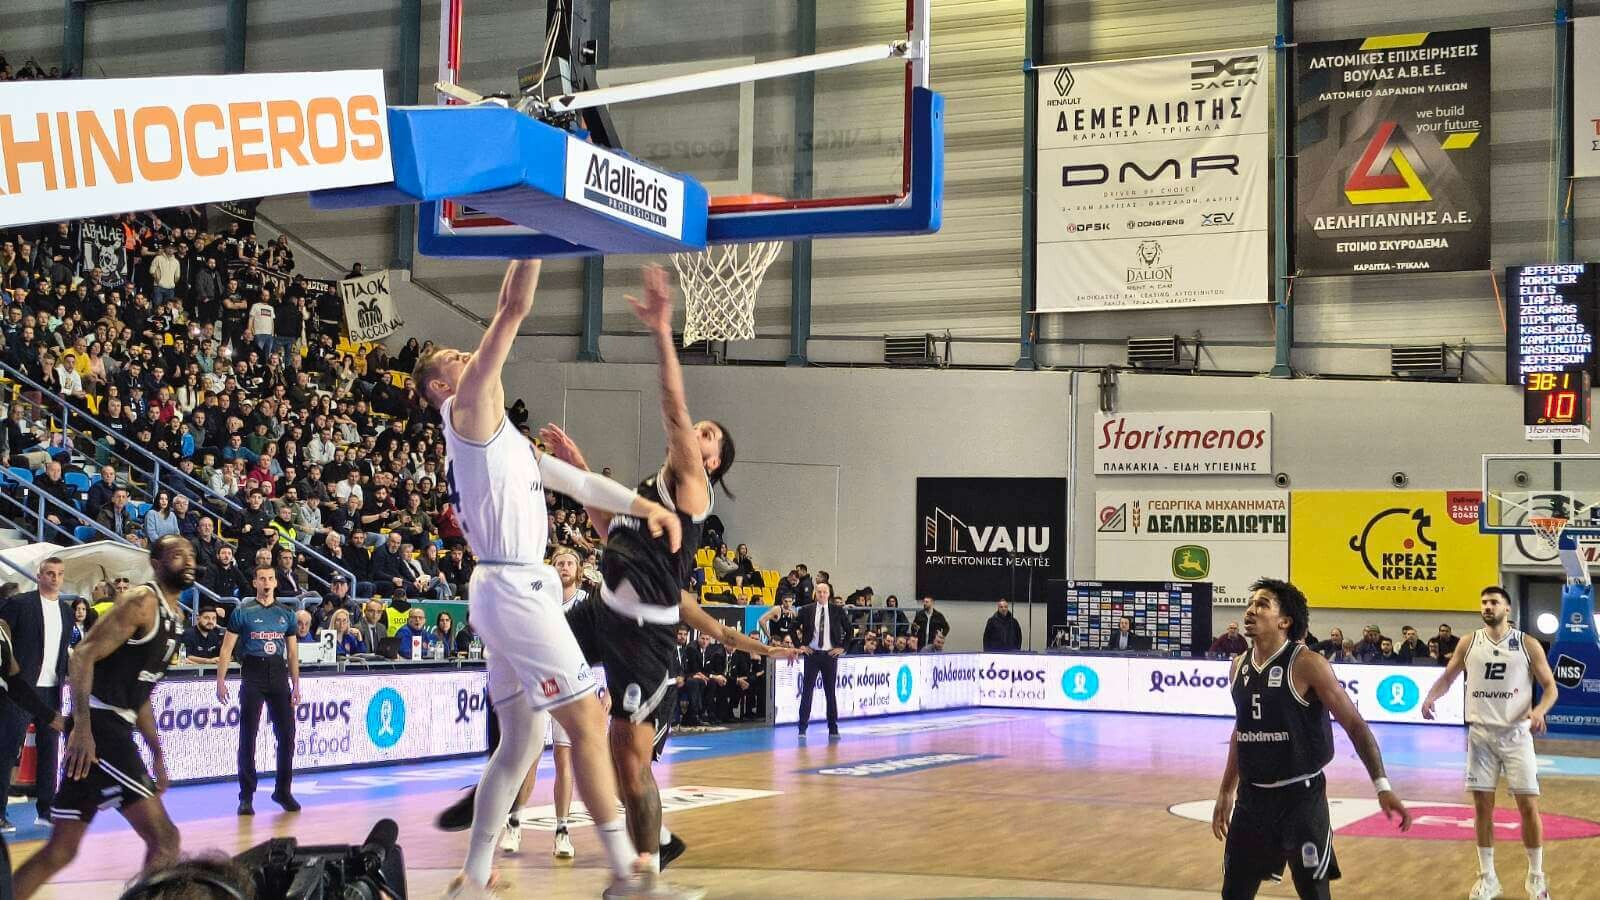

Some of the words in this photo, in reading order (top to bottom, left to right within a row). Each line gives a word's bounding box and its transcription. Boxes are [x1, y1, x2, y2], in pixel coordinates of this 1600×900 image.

[1309, 52, 1385, 69] ΛΑΤΟΜΙΚΕΣ
[1387, 44, 1479, 63] ΕΠΙΧΕΙΡΗΣΕΙΣ
[1343, 67, 1394, 83] ΒΟΥΛΑΣ
[1398, 64, 1446, 79] Α.Β.Ε.Ε.
[1191, 78, 1259, 91] DACIA
[1319, 87, 1373, 101] ΛΑΤΟΜΕΙΟ
[1375, 84, 1426, 97] ΑΔΡΑΝΩΝ
[1428, 81, 1468, 93] ΥΛΙΚΩΝ
[1046, 97, 1081, 107] RENAULT
[1055, 97, 1243, 132] ΔΕΜΕΡΛΙΩΤΗΣ
[1416, 110, 1433, 118] we
[1436, 105, 1465, 117] build
[1073, 129, 1139, 141] ΚΑΡΔΙΤΣΑ
[1161, 123, 1221, 135] ΤΡΙΚΑΛΑ
[1416, 123, 1442, 135] your
[1444, 118, 1482, 131] future.
[0, 94, 384, 195] HINOCEROS
[1061, 154, 1240, 187] DMR
[585, 153, 668, 213] Malliaris
[608, 198, 667, 228] PROFESSIONAL
[1313, 211, 1438, 231] ΔΕΛΗΓΙΑΝΝΗΣ
[1441, 210, 1473, 224] Α.Ε.
[1076, 222, 1111, 232] DFSK
[1137, 218, 1185, 228] DONGFENG
[1336, 241, 1377, 253] ΕΤΟΙΜΟ
[1379, 237, 1449, 251] ΣΚΥΡΟΔΕΜΑ
[1353, 263, 1391, 271] ΚΑΡΔΙΤΣΑ
[1396, 261, 1430, 270] ΤΡΙΚΑΛΑ
[1520, 265, 1584, 276] JEFFERSON
[1127, 266, 1173, 283] DALION
[1520, 275, 1577, 285] HORCHLER
[343, 275, 389, 304] ΠΑΟΚ
[1520, 285, 1556, 295] ELLIS
[1520, 315, 1577, 325] DIPLAROS
[1520, 324, 1584, 335] KASELAKIS
[1520, 334, 1592, 345] KAMPERIDIS
[1520, 344, 1592, 355] WASHINGTON
[1520, 354, 1584, 365] JEFFERSON
[1545, 393, 1577, 419] 10
[1098, 417, 1266, 450] Storismenos
[1103, 462, 1159, 471] ΠΛΑΚΑΚΙΑ
[1173, 462, 1199, 471] ΕΙΔΗ
[1205, 462, 1257, 471] ΥΓΙΕΙΝΗΣ
[1148, 500, 1202, 511] ΓΕΩΡΓΙΚΑ
[1205, 499, 1286, 511] ΜΗΧΑΝΗΜΑΤΑ
[1147, 514, 1286, 534] ΔΕΛΗΒΕΛΙΩΤΗ
[968, 526, 1050, 552] VAIU
[925, 556, 1004, 567] ΑΡΧΙΤΕΚΤΟΝΙΚΕΣ
[1006, 555, 1050, 567] ΜΕΛΕΤΕΣ
[1382, 553, 1437, 567] ΚΡΕΑΣ
[1382, 567, 1437, 581] ΚΡΕΑΣ
[1340, 583, 1447, 594] www.kreas-kreas.gr
[856, 665, 890, 691] κόσμος
[979, 662, 1046, 682] κόσμος
[1484, 662, 1507, 680] 12
[1557, 666, 1581, 680] INSS
[1251, 693, 1263, 721] 5
